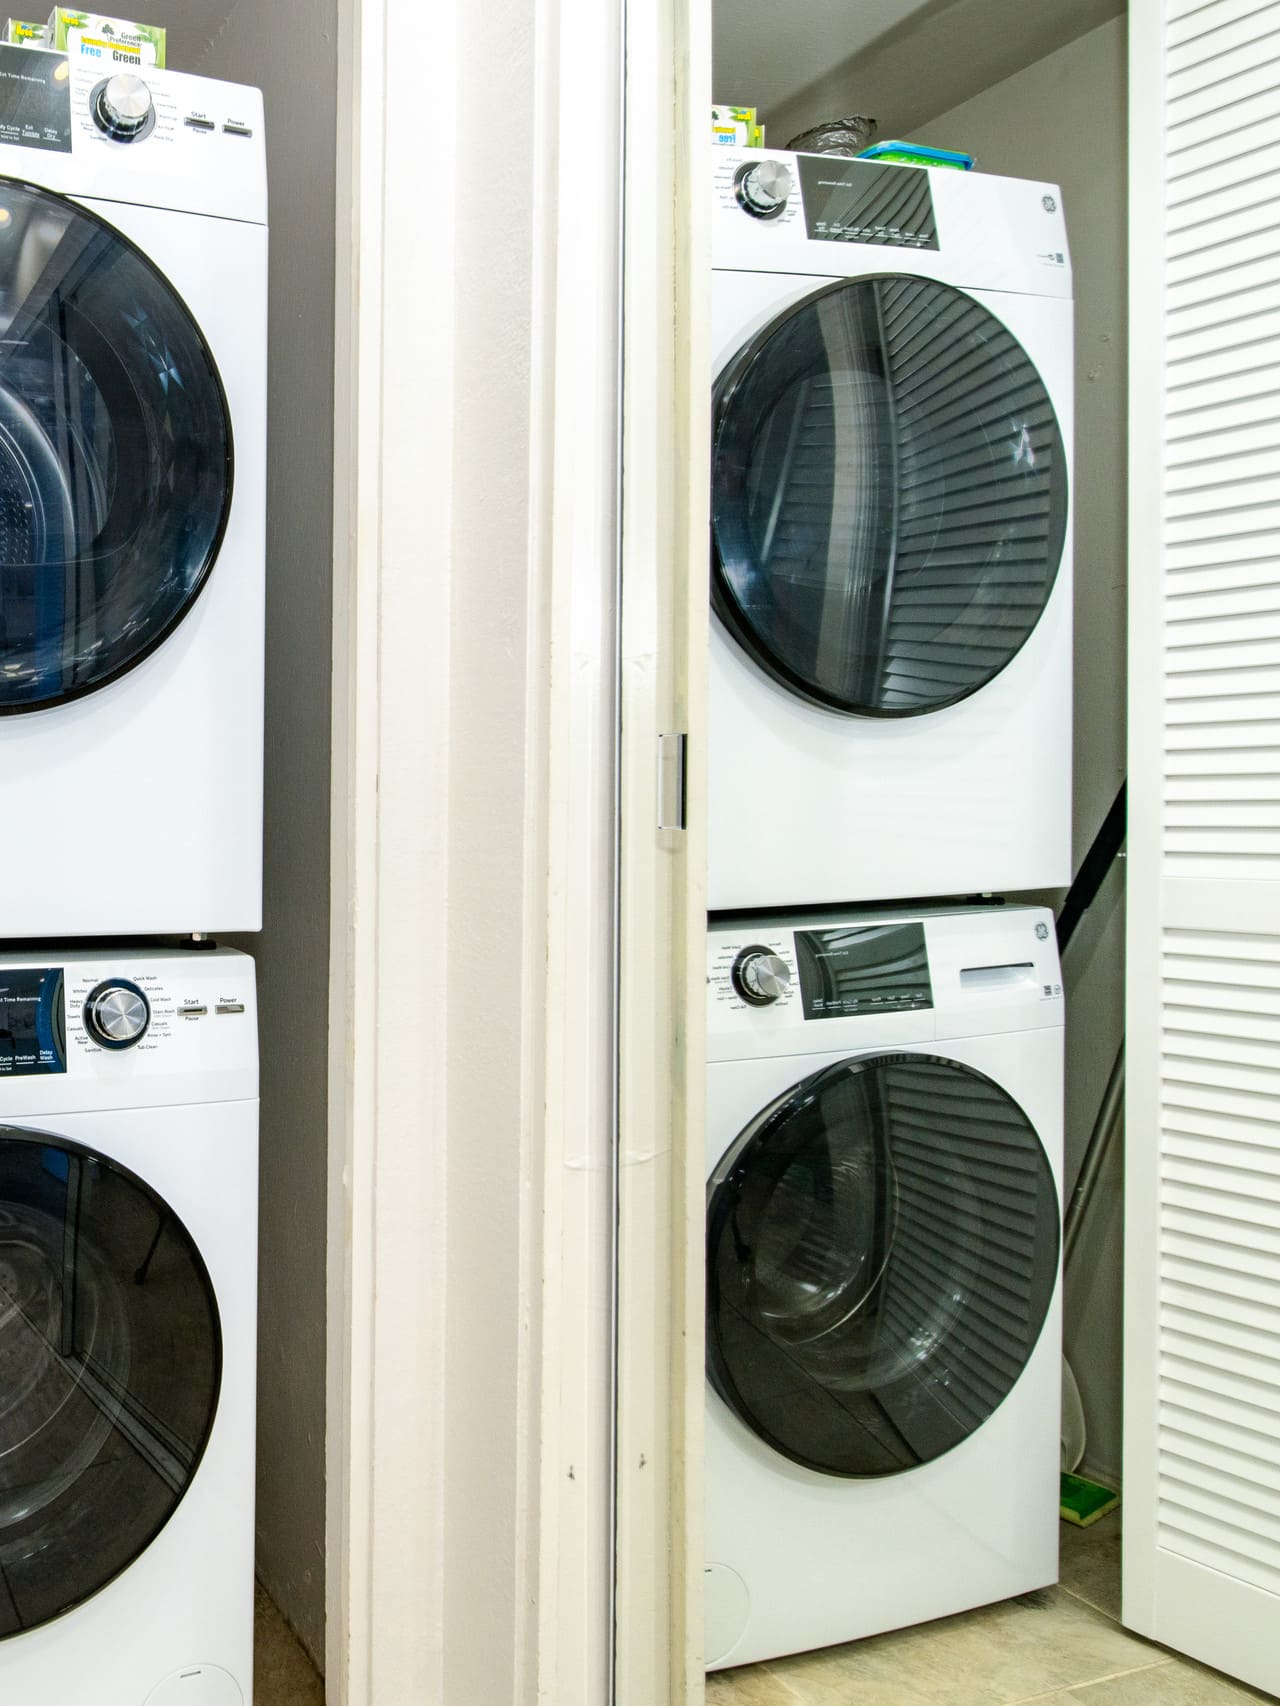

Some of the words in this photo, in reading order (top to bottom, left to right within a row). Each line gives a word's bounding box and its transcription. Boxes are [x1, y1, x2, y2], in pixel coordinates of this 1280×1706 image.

[81, 43, 101, 57] Free
[112, 50, 141, 65] Green
[20, 74, 46, 84] Remaining
[191, 111, 206, 119] Start
[227, 118, 245, 127] Power
[6, 124, 20, 132] Cycle
[0, 1055, 13, 1063] Cycle
